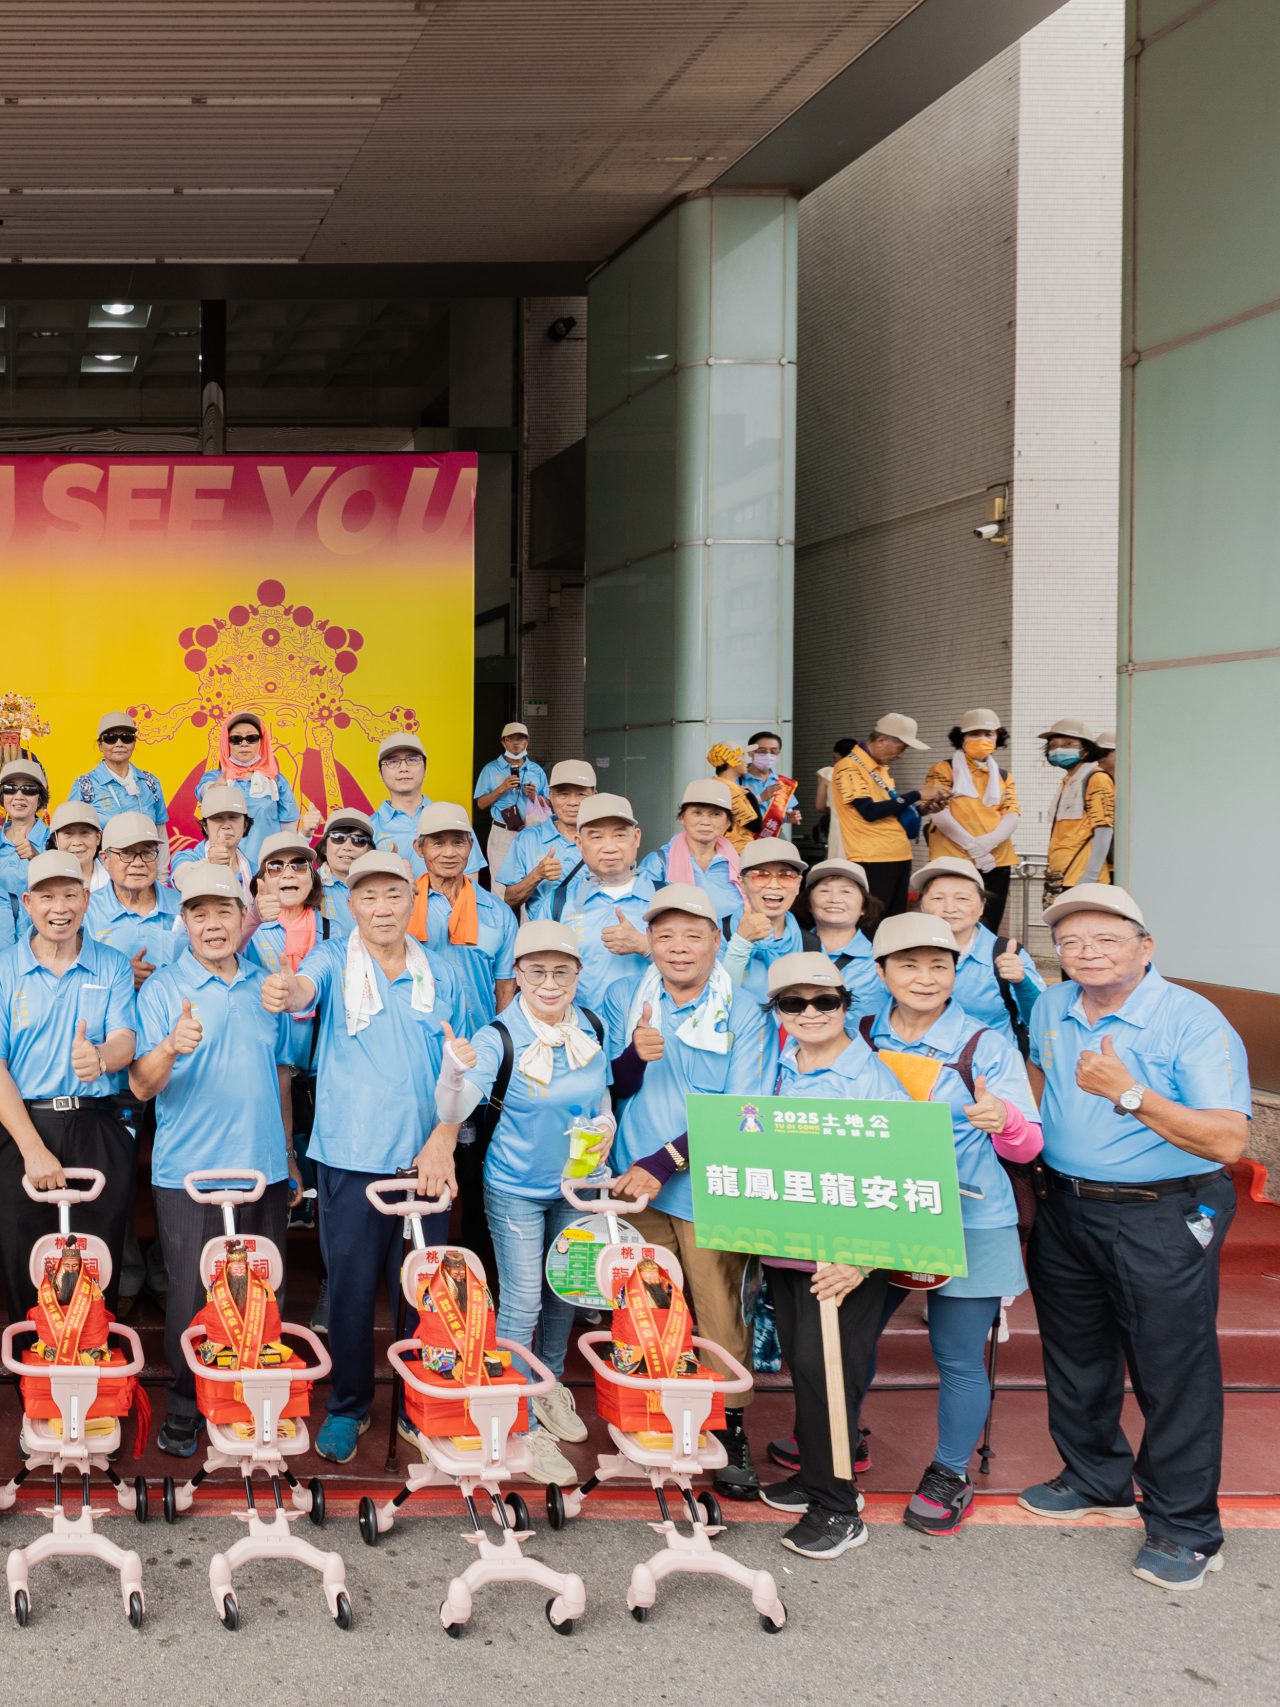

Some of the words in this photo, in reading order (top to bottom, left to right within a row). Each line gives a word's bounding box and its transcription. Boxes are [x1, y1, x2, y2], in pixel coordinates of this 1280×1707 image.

[42, 463, 234, 551] SEE
[257, 465, 477, 555] YOU
[773, 1110, 819, 1124] 2025
[821, 1113, 889, 1129] 土地公
[706, 1164, 942, 1215] 龍鳳里龍安祠
[620, 1246, 655, 1260] 桃園
